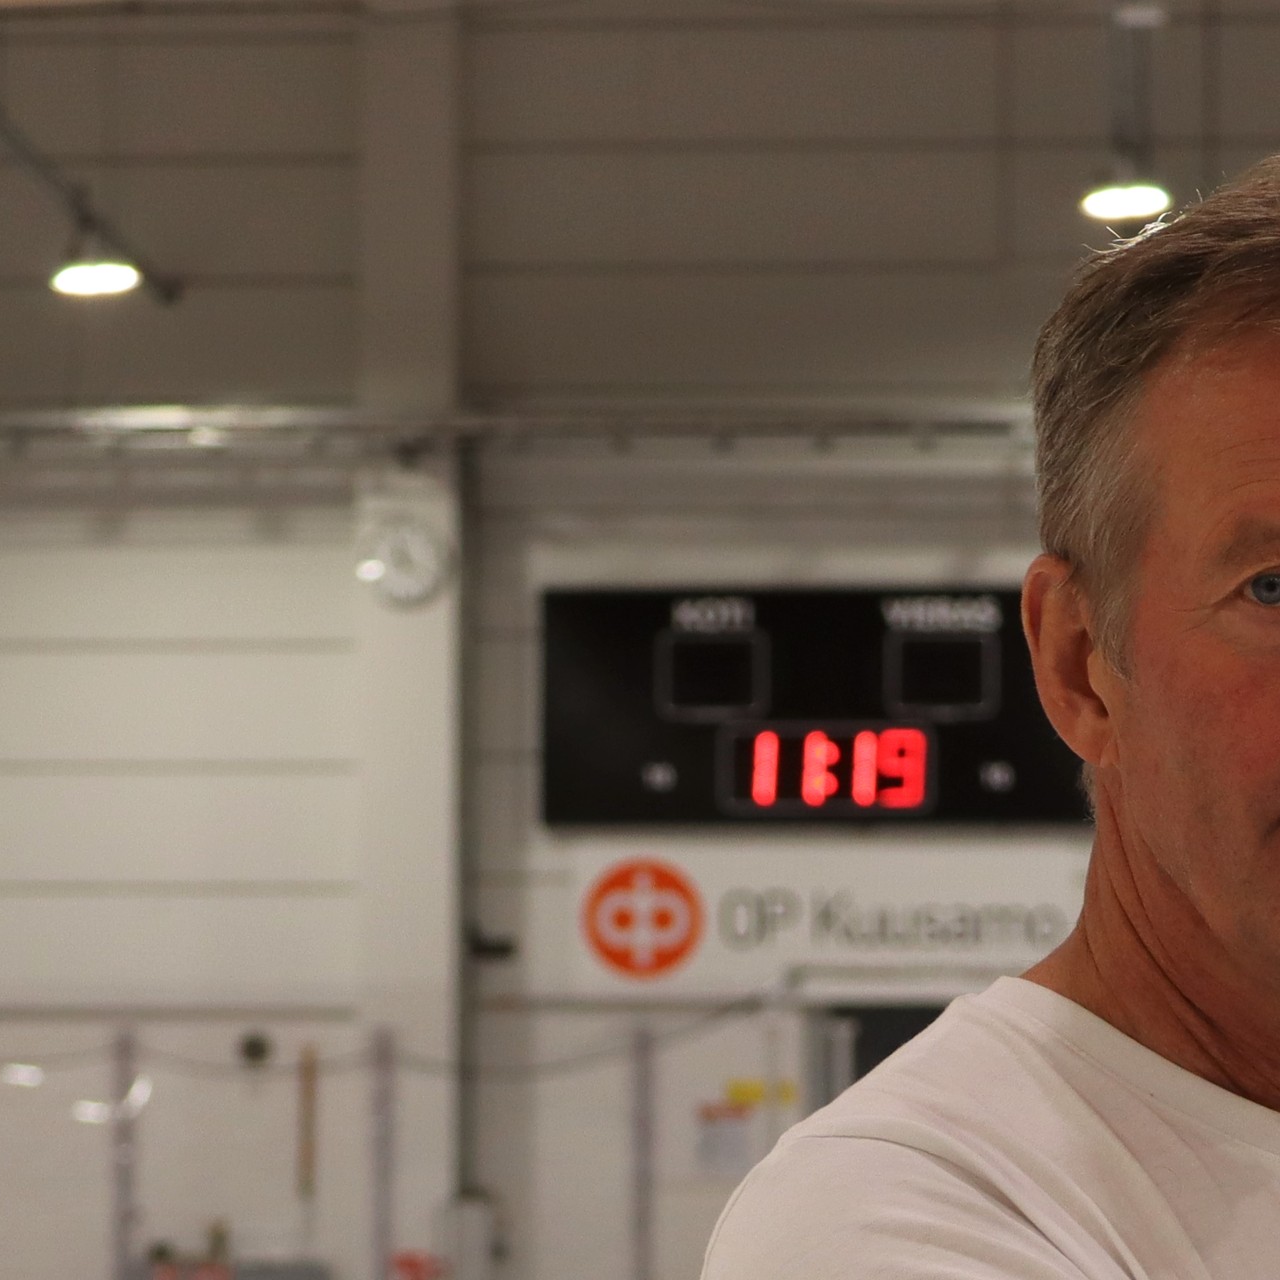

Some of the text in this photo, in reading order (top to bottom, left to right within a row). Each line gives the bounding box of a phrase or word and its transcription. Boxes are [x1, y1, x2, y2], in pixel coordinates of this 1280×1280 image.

[751, 728, 927, 809] 11:19
[719, 889, 1064, 951] OP Kuusamo
